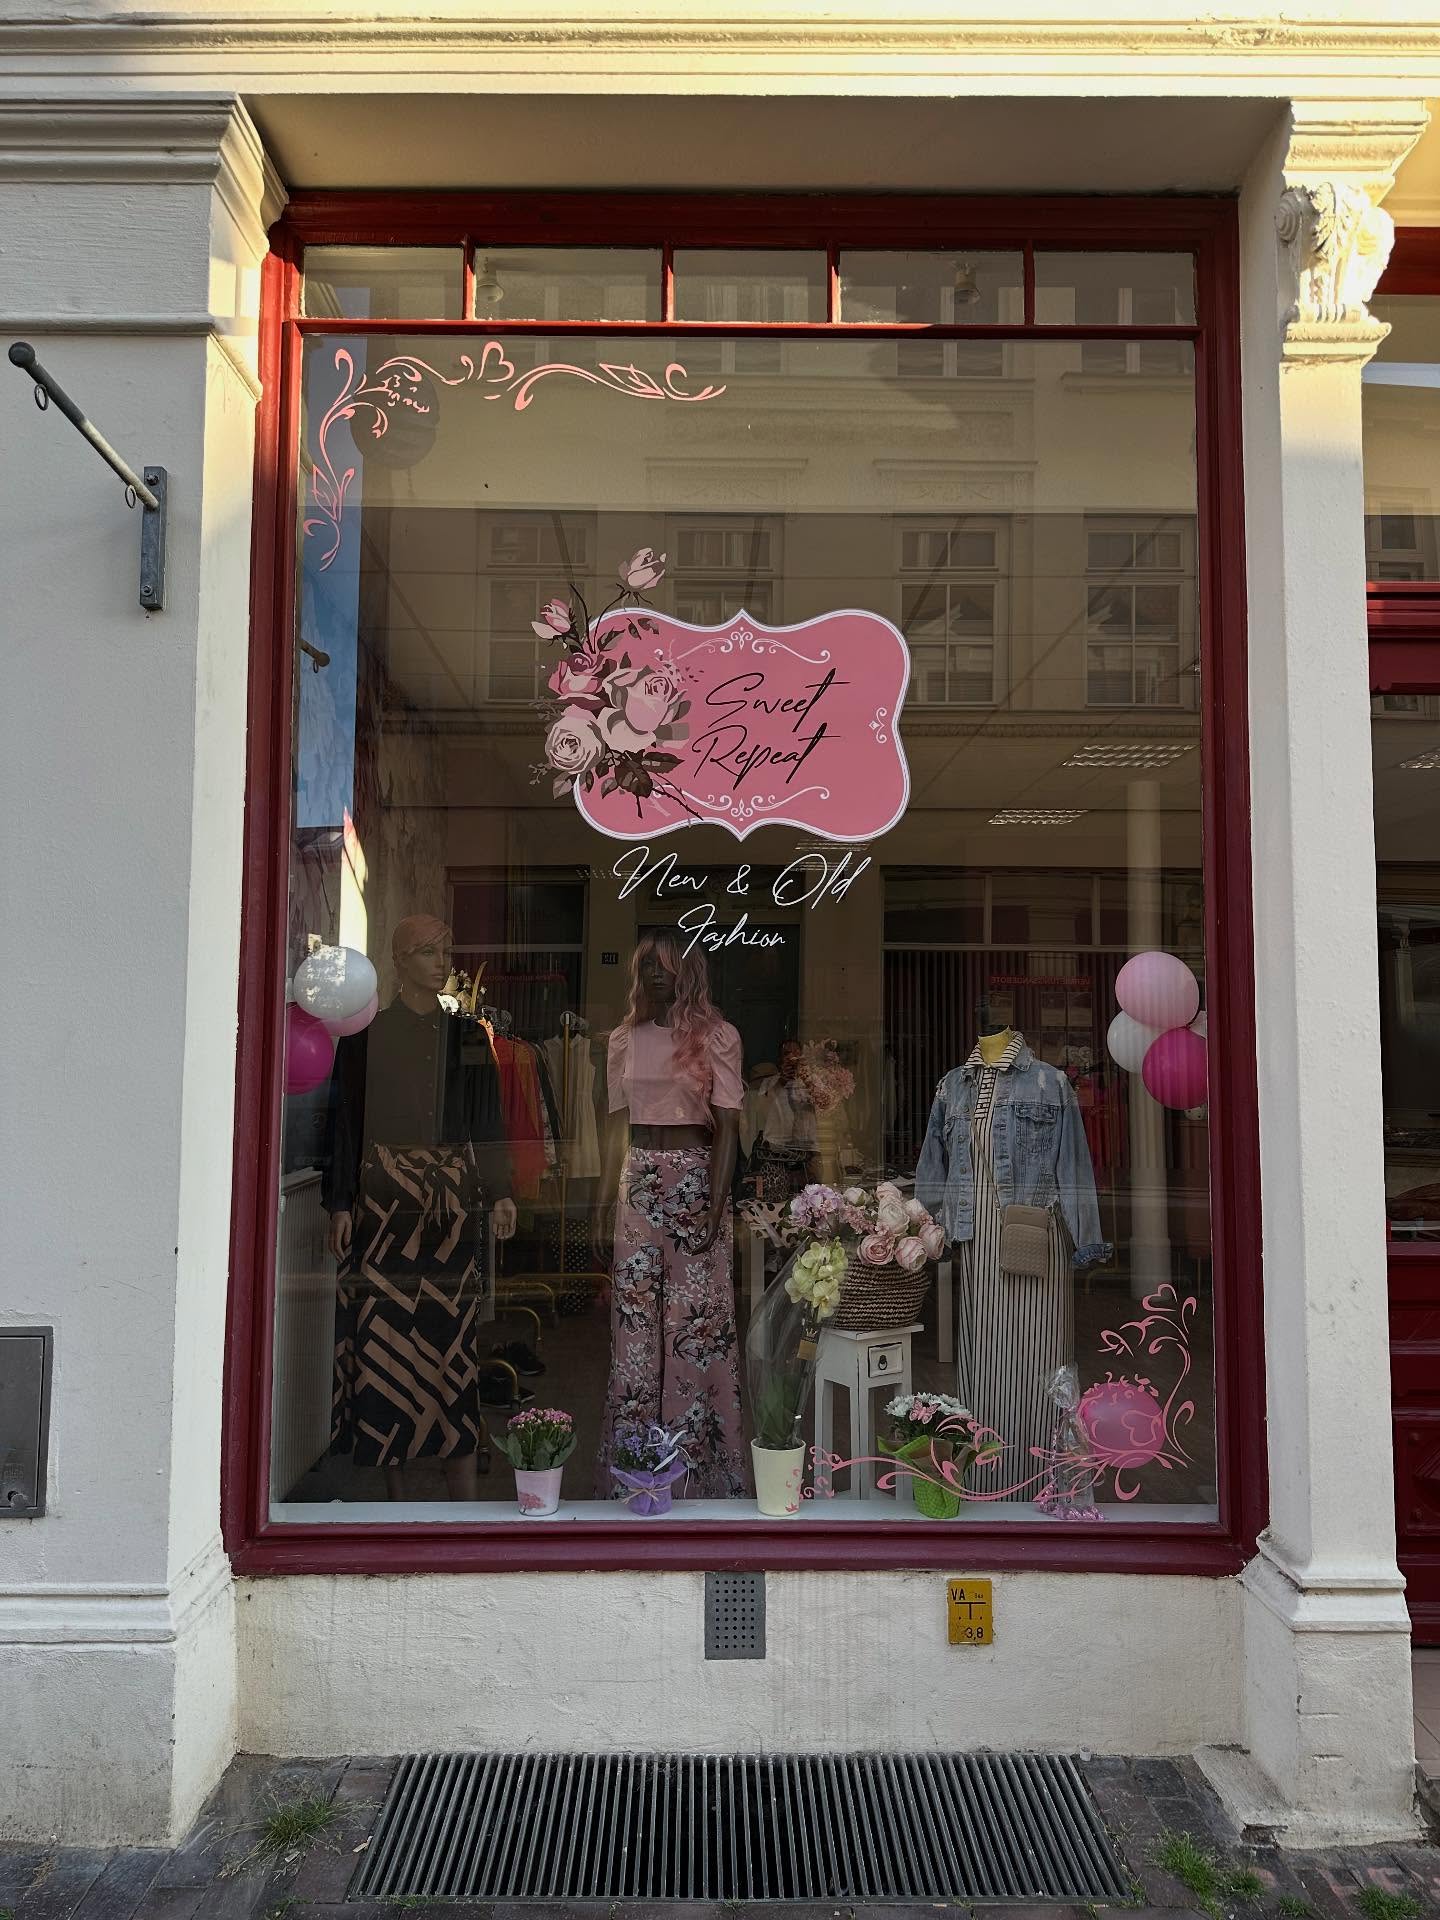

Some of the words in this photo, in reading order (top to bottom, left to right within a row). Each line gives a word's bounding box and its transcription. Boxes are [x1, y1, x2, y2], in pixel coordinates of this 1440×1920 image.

[705, 668, 851, 732] Sweet
[693, 722, 841, 790] Repeat
[613, 846, 707, 900] New
[726, 864, 751, 895] &
[772, 852, 872, 910] Old
[678, 904, 786, 959] Fashion
[951, 1588, 966, 1601] VA
